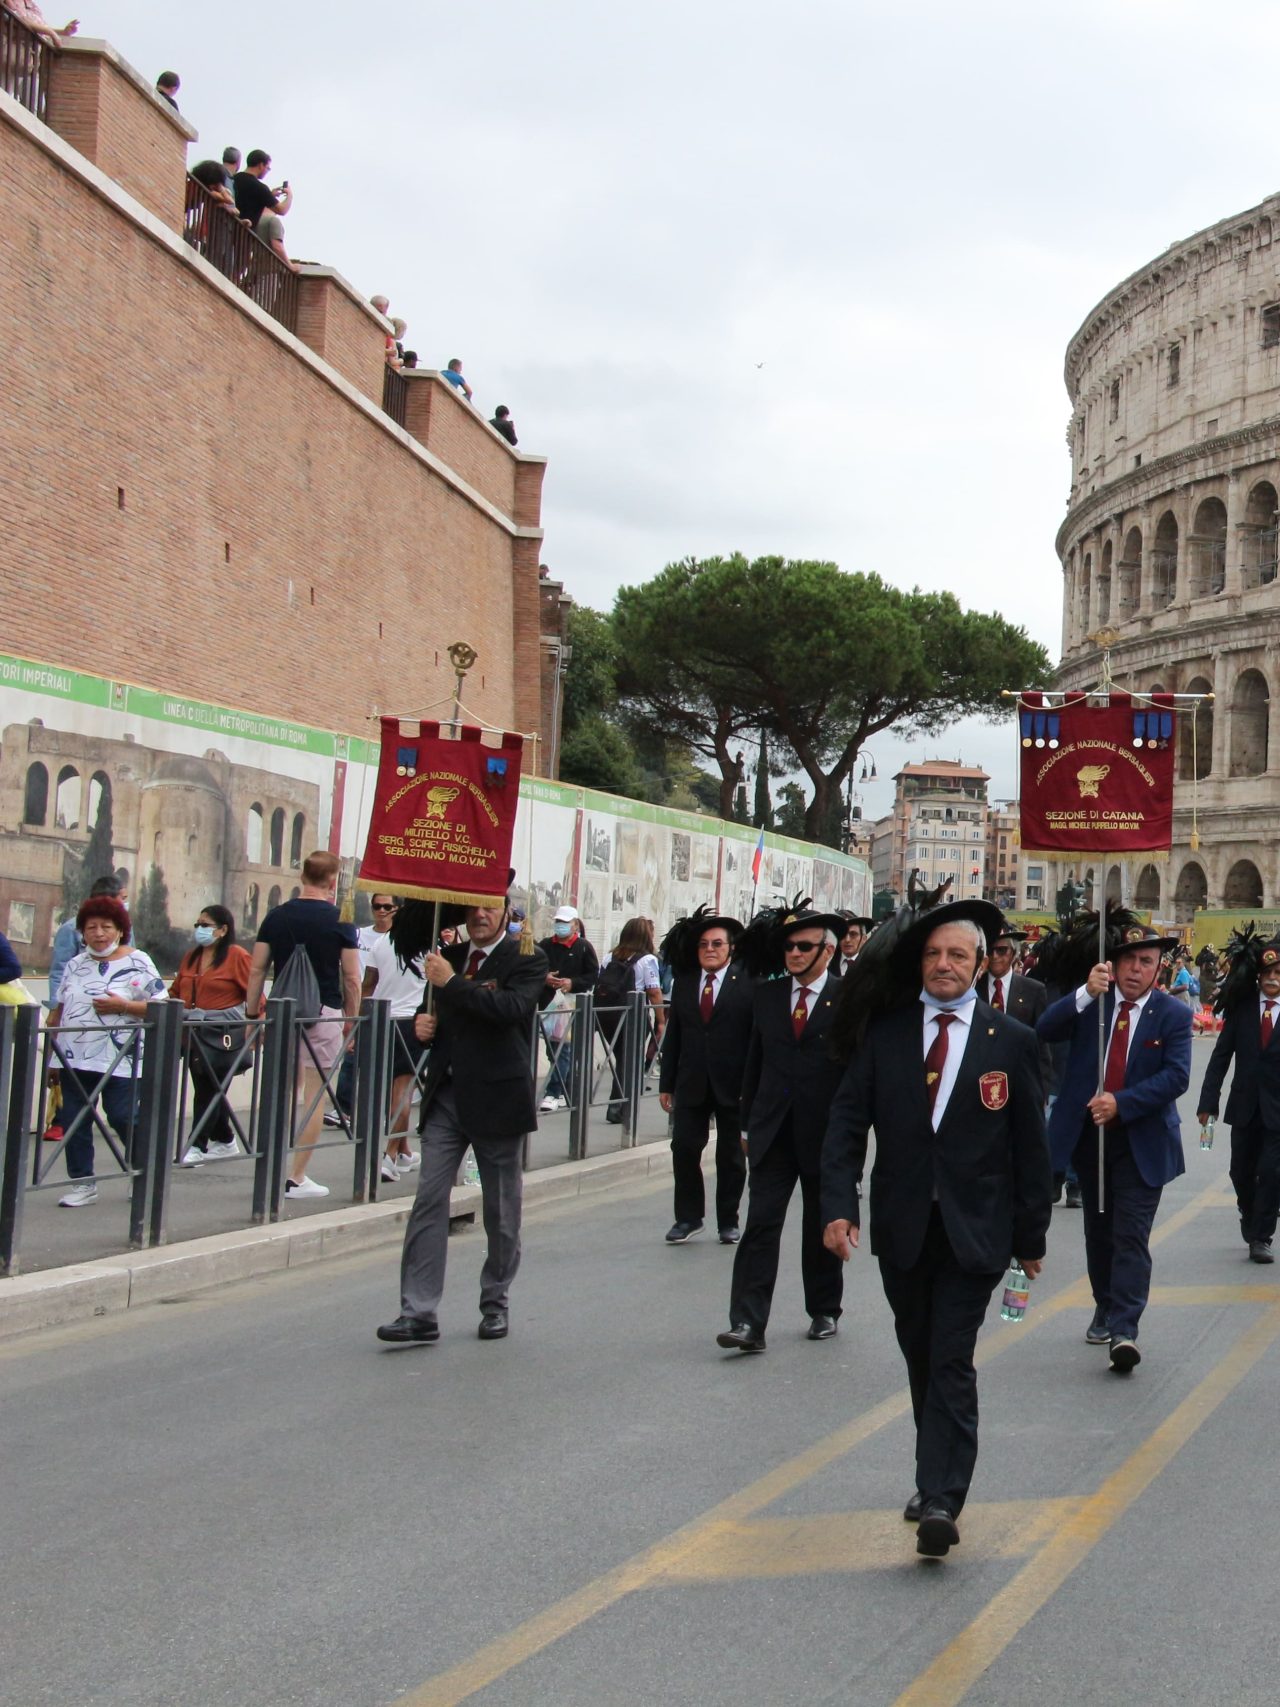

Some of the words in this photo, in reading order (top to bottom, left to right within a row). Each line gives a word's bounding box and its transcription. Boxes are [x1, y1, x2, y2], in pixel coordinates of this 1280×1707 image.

[23, 667, 72, 693] IMPERIALI
[163, 701, 187, 719] LINEA
[188, 706, 194, 721] C
[218, 714, 279, 739] METROPOLITANA
[280, 727, 288, 741] DI
[288, 729, 308, 745] ROMA
[1036, 745, 1076, 786] ASSOCIAZIONE
[1077, 739, 1116, 752] NAZIONALE
[1118, 747, 1156, 787] BERSAGLIERI
[385, 774, 429, 813] ASSOCIAZIONE
[430, 771, 469, 786] NAZIONALE
[413, 818, 453, 831] SEZIONE
[456, 824, 467, 833] DI
[1045, 811, 1087, 821] SEZIONE
[1090, 810, 1099, 820] DI
[1102, 811, 1145, 821] CATANIA
[1068, 822, 1091, 830] MICHELE
[378, 835, 406, 847] SERG.
[442, 842, 497, 859] RISICHELLA
[404, 827, 450, 840] MILITELLO
[454, 834, 472, 845] V.C.
[385, 846, 446, 860] SEBASTIANO
[448, 854, 487, 868] M.O.V.M.
